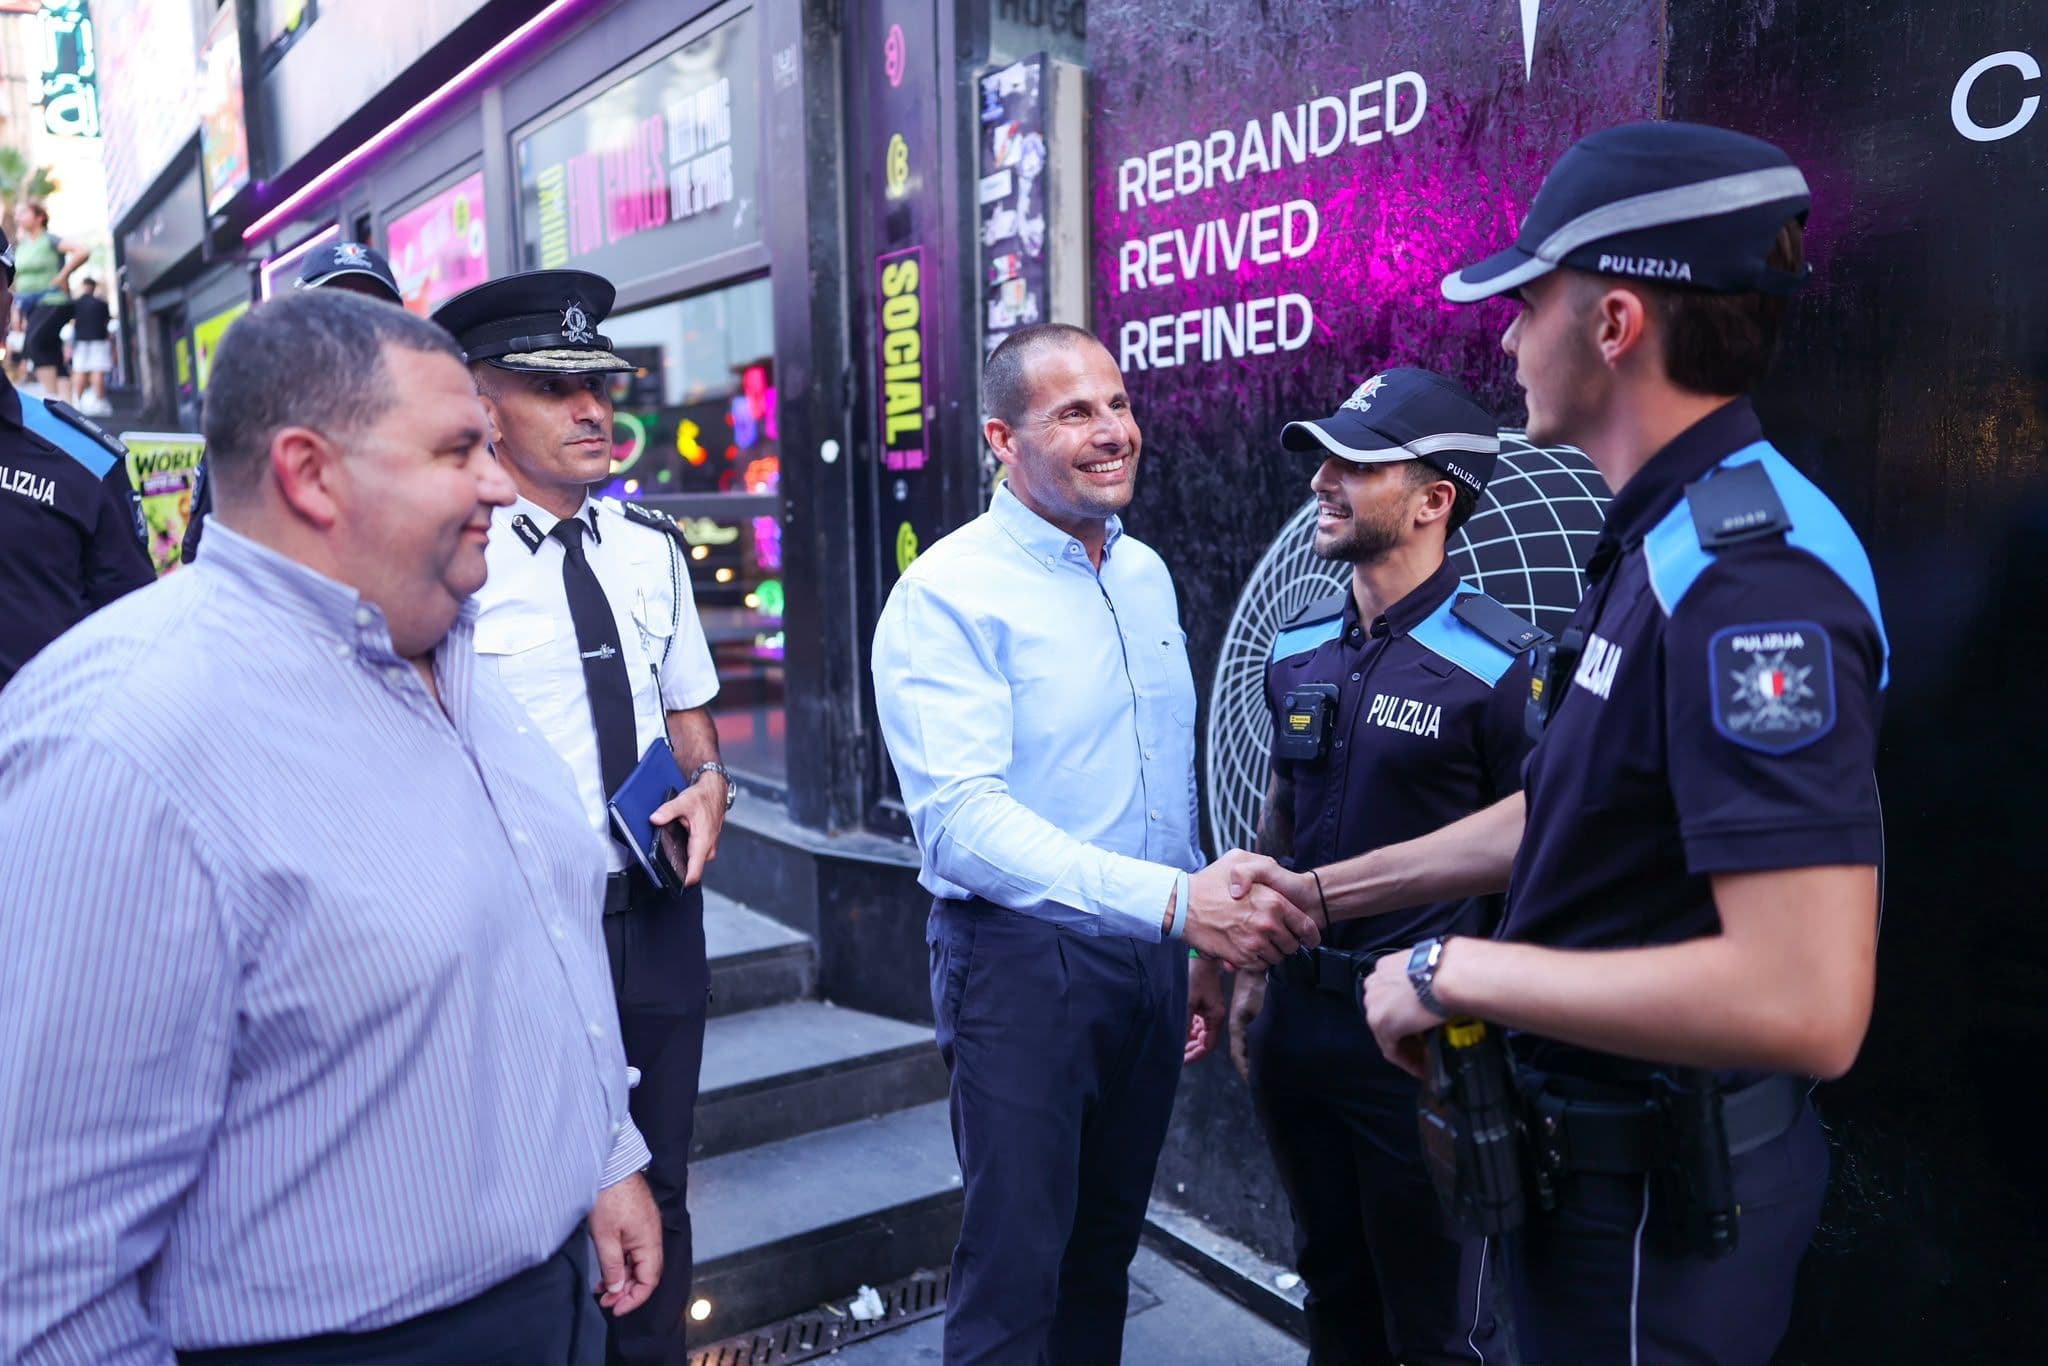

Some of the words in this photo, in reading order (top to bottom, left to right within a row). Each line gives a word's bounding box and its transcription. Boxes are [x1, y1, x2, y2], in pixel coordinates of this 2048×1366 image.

[1118, 70, 1428, 212] REBRANDED
[1119, 199, 1319, 293] REVIVED
[1599, 253, 1693, 282] PULIZIJA
[881, 259, 923, 445] SOCIAL
[1120, 292, 1314, 373] REFINED
[1446, 462, 1482, 492] PULIZIJA
[1731, 631, 1805, 652] PULIZIJA
[1366, 692, 1442, 739] PULIZIJA
